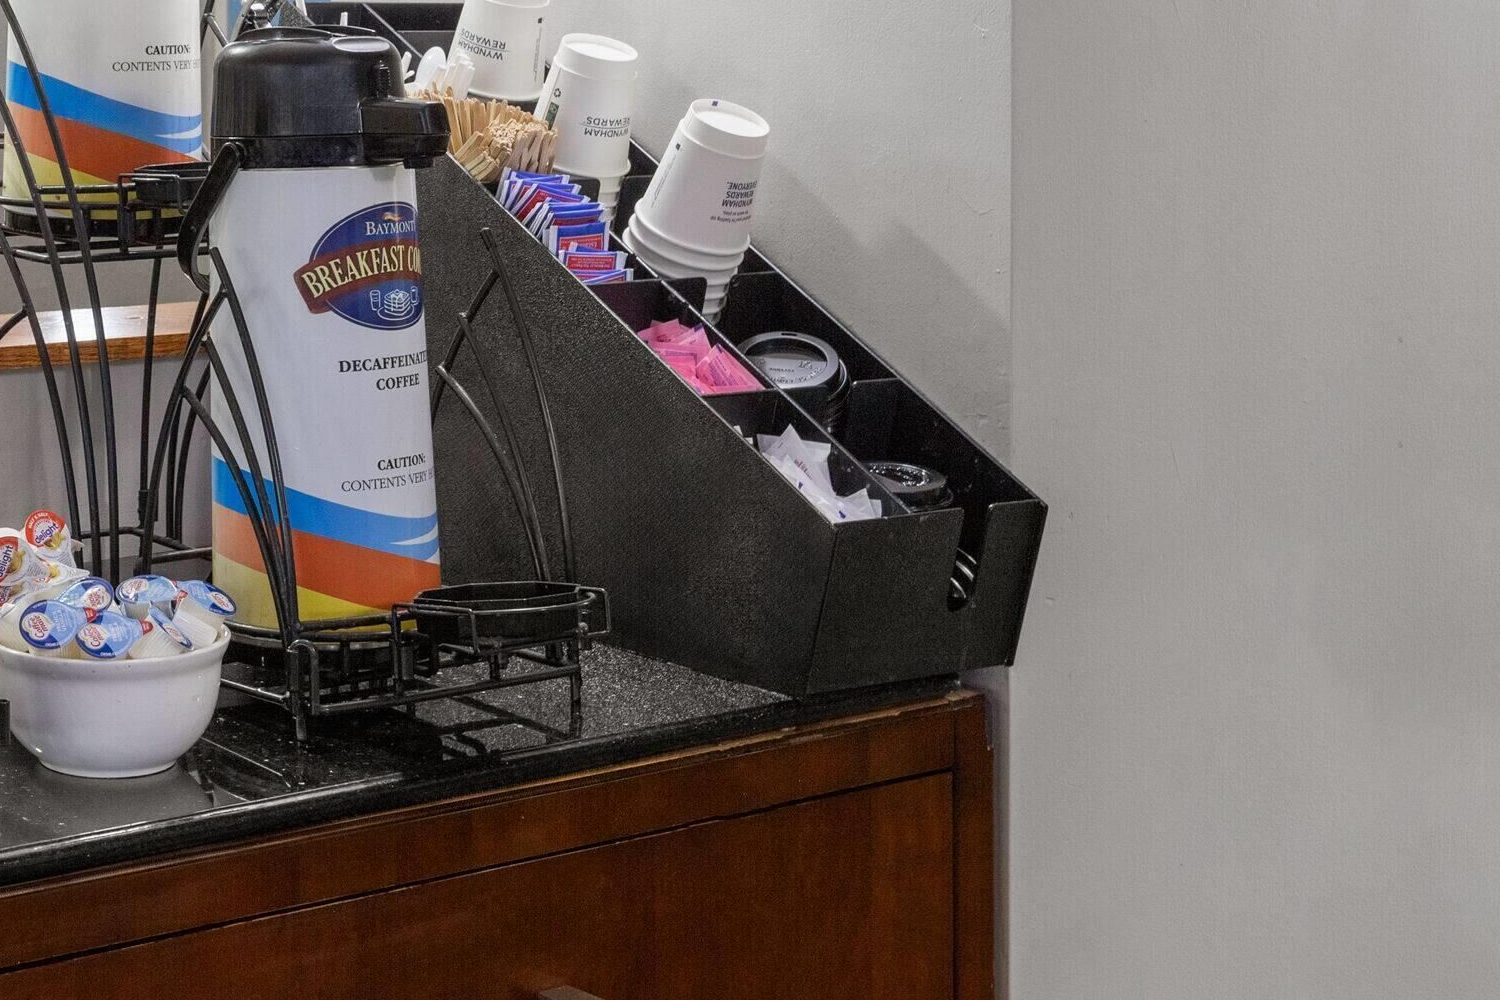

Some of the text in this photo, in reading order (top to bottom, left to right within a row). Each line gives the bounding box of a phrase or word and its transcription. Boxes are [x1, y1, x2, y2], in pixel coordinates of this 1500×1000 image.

[461, 28, 506, 50] REWARDS
[458, 40, 503, 60] WYNDHAM
[112, 61, 171, 72] CONTENTS
[365, 220, 416, 236] BAYMONT
[301, 244, 404, 298] BREAKFAST
[338, 350, 427, 373] DECAFFEINATE
[376, 373, 420, 391] COFFEE
[377, 453, 426, 471] CAUTION:
[341, 475, 407, 492] CONTENTS
[408, 471, 428, 484] VERY
[35, 523, 59, 544] delight
